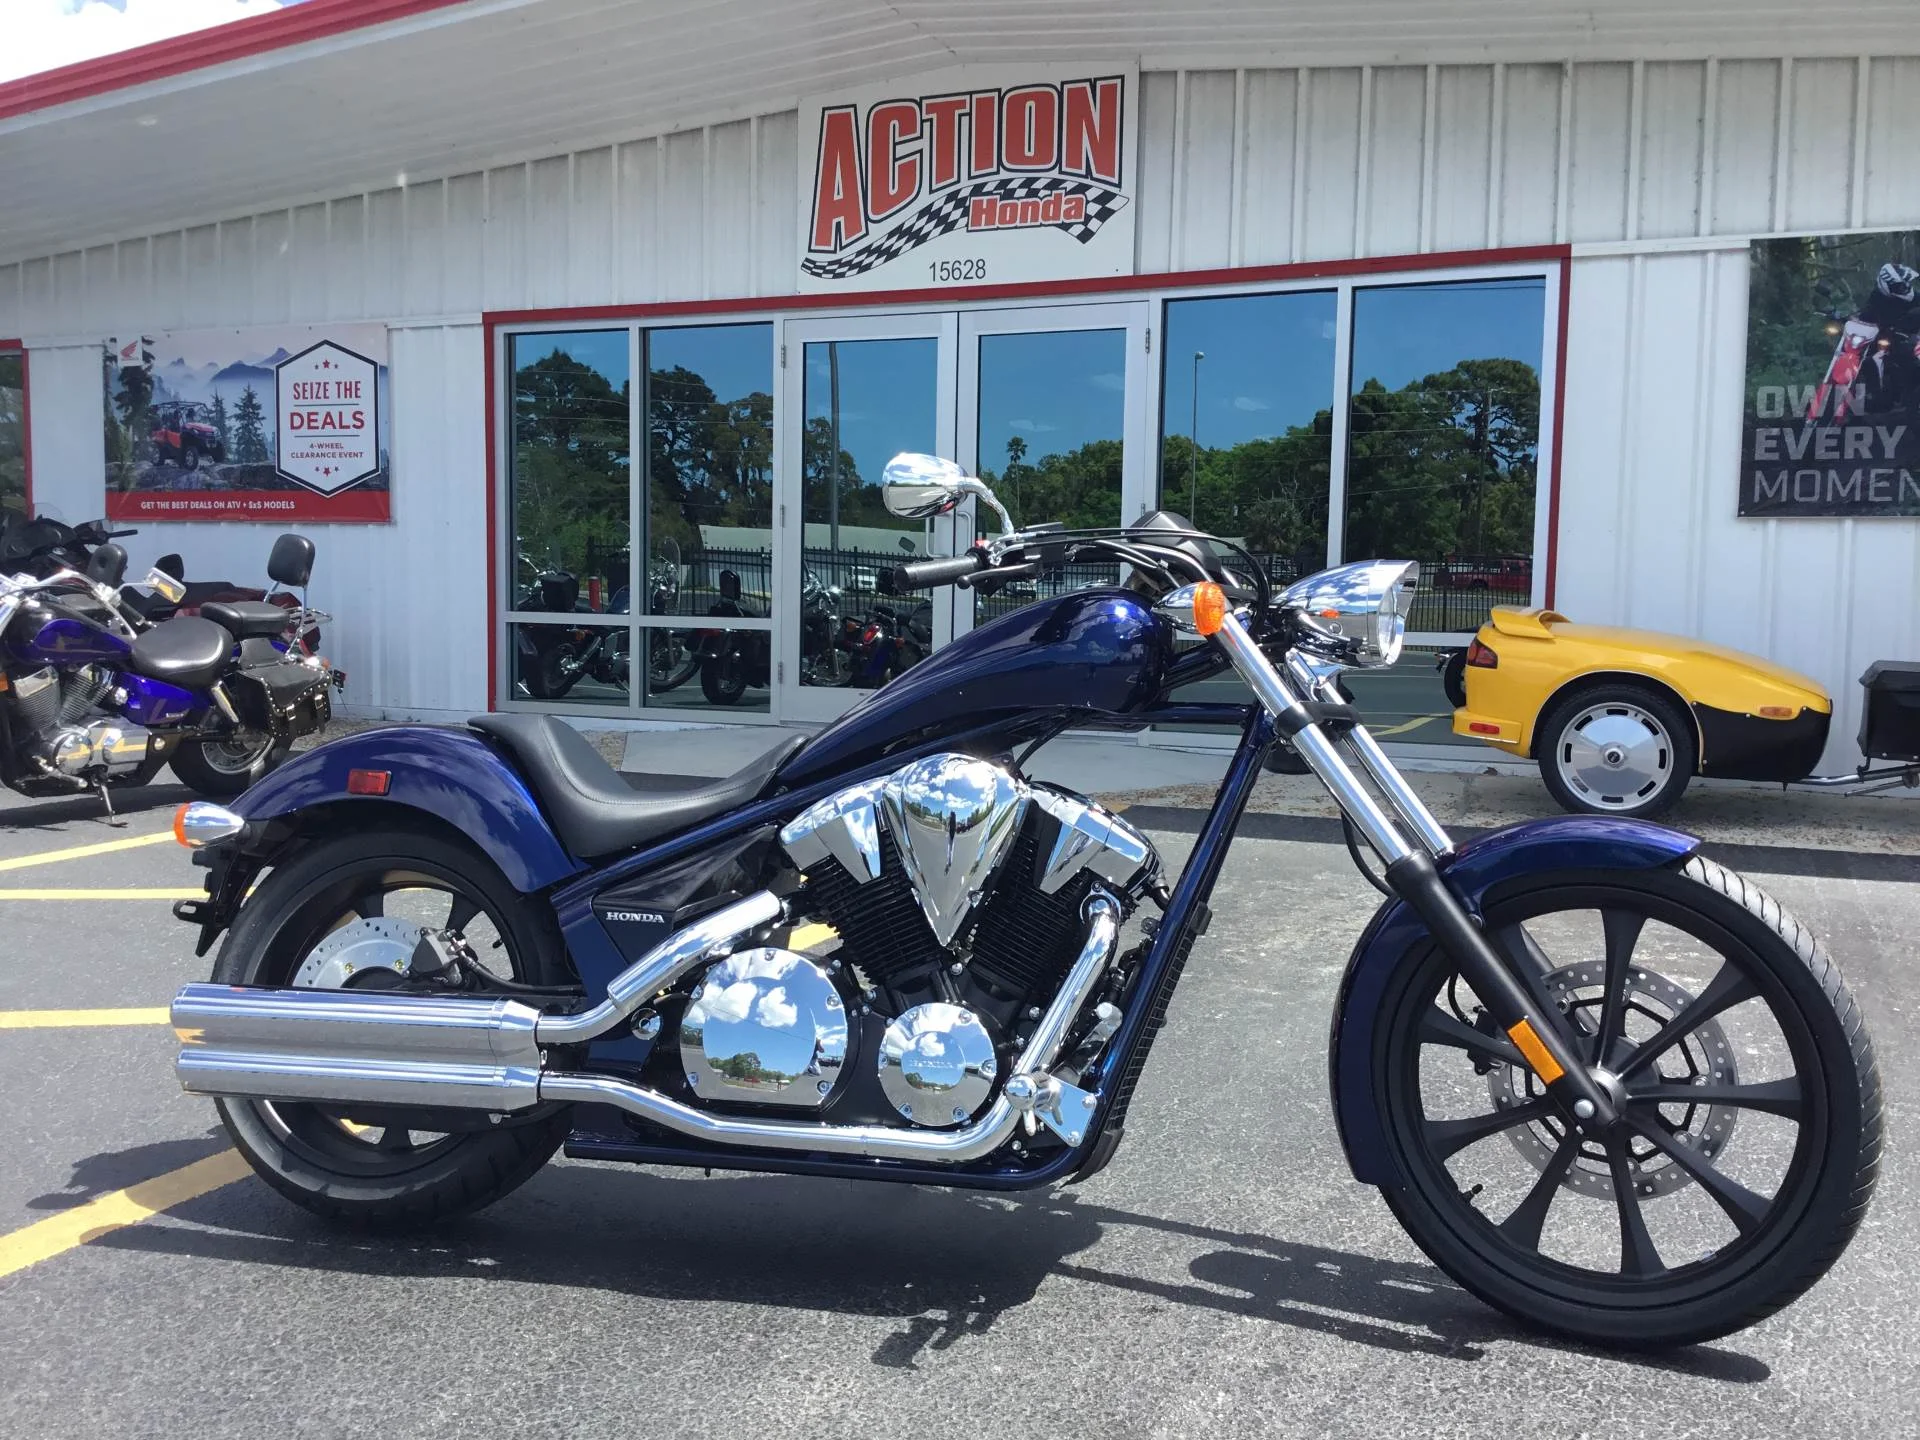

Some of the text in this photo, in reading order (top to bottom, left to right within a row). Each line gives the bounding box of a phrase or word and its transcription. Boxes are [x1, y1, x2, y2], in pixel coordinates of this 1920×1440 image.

[808, 74, 1125, 254] ACTION
[967, 191, 1087, 232] Honda
[929, 259, 986, 282] 15628
[293, 381, 361, 400] SEIZE THE
[1756, 383, 1866, 418] OWN
[290, 411, 365, 430] DEALS
[1754, 425, 1907, 460] EVERY
[141, 501, 155, 509] GET
[157, 501, 170, 509] THE
[171, 501, 189, 509] BEST
[190, 501, 212, 509] DEALS
[213, 501, 225, 509] ON
[226, 501, 241, 509] ATV
[263, 501, 295, 509] MODELS
[606, 912, 665, 923] HONDA
